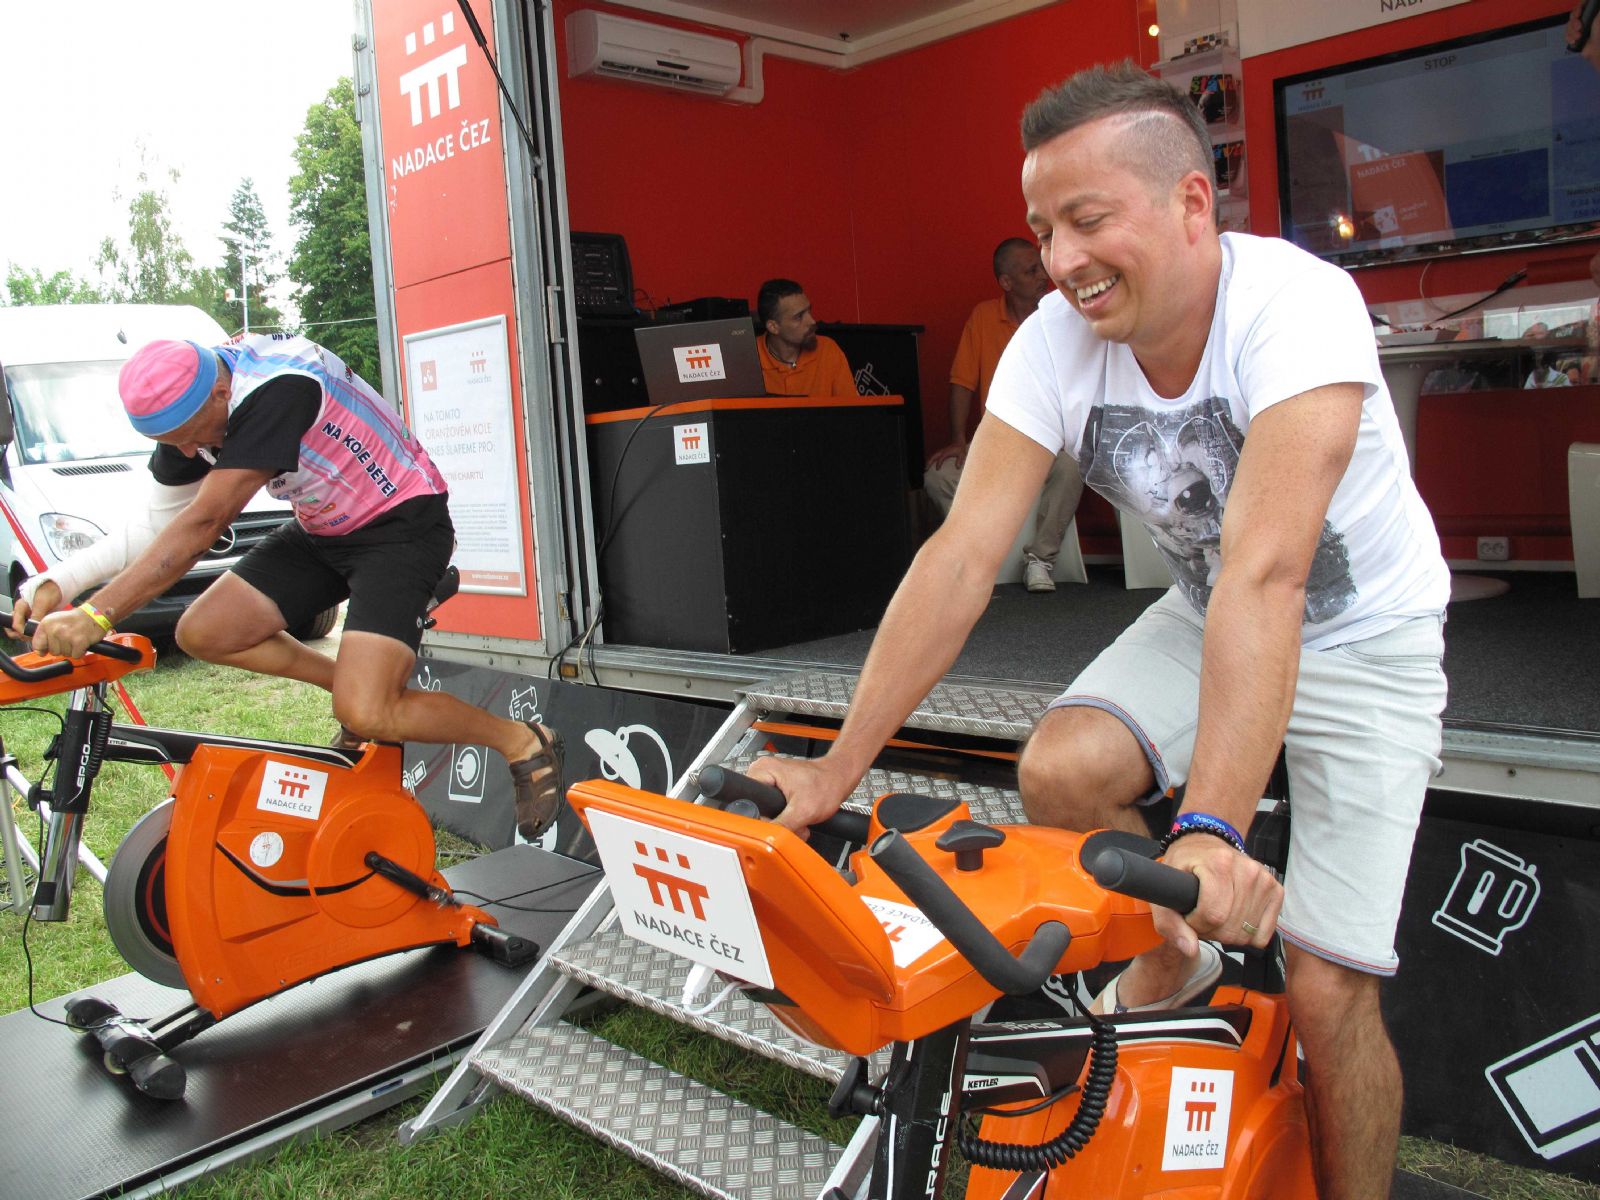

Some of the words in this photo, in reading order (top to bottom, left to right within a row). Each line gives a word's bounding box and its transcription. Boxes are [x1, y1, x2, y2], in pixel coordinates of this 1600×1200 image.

[1424, 55, 1457, 71] STOP
[392, 133, 454, 180] NADACE
[459, 118, 491, 152] ČEZ
[424, 411, 434, 423] NA
[435, 408, 461, 421] TOMTO
[321, 421, 342, 441] NA
[425, 423, 472, 440] ORANŽOVÉM
[472, 422, 493, 435] KOLE
[445, 441, 477, 456] ŠLAPEME
[76, 743, 91, 788] ERGO
[265, 797, 297, 810] NADACE
[298, 803, 313, 813] ČEZ
[633, 909, 705, 951] NADACE
[710, 932, 745, 964] ČEZ
[967, 1077, 999, 1089] KETTLER
[925, 1091, 952, 1196] RACE
[1172, 1143, 1204, 1157] NADACE
[1205, 1139, 1219, 1155] ČEZ
